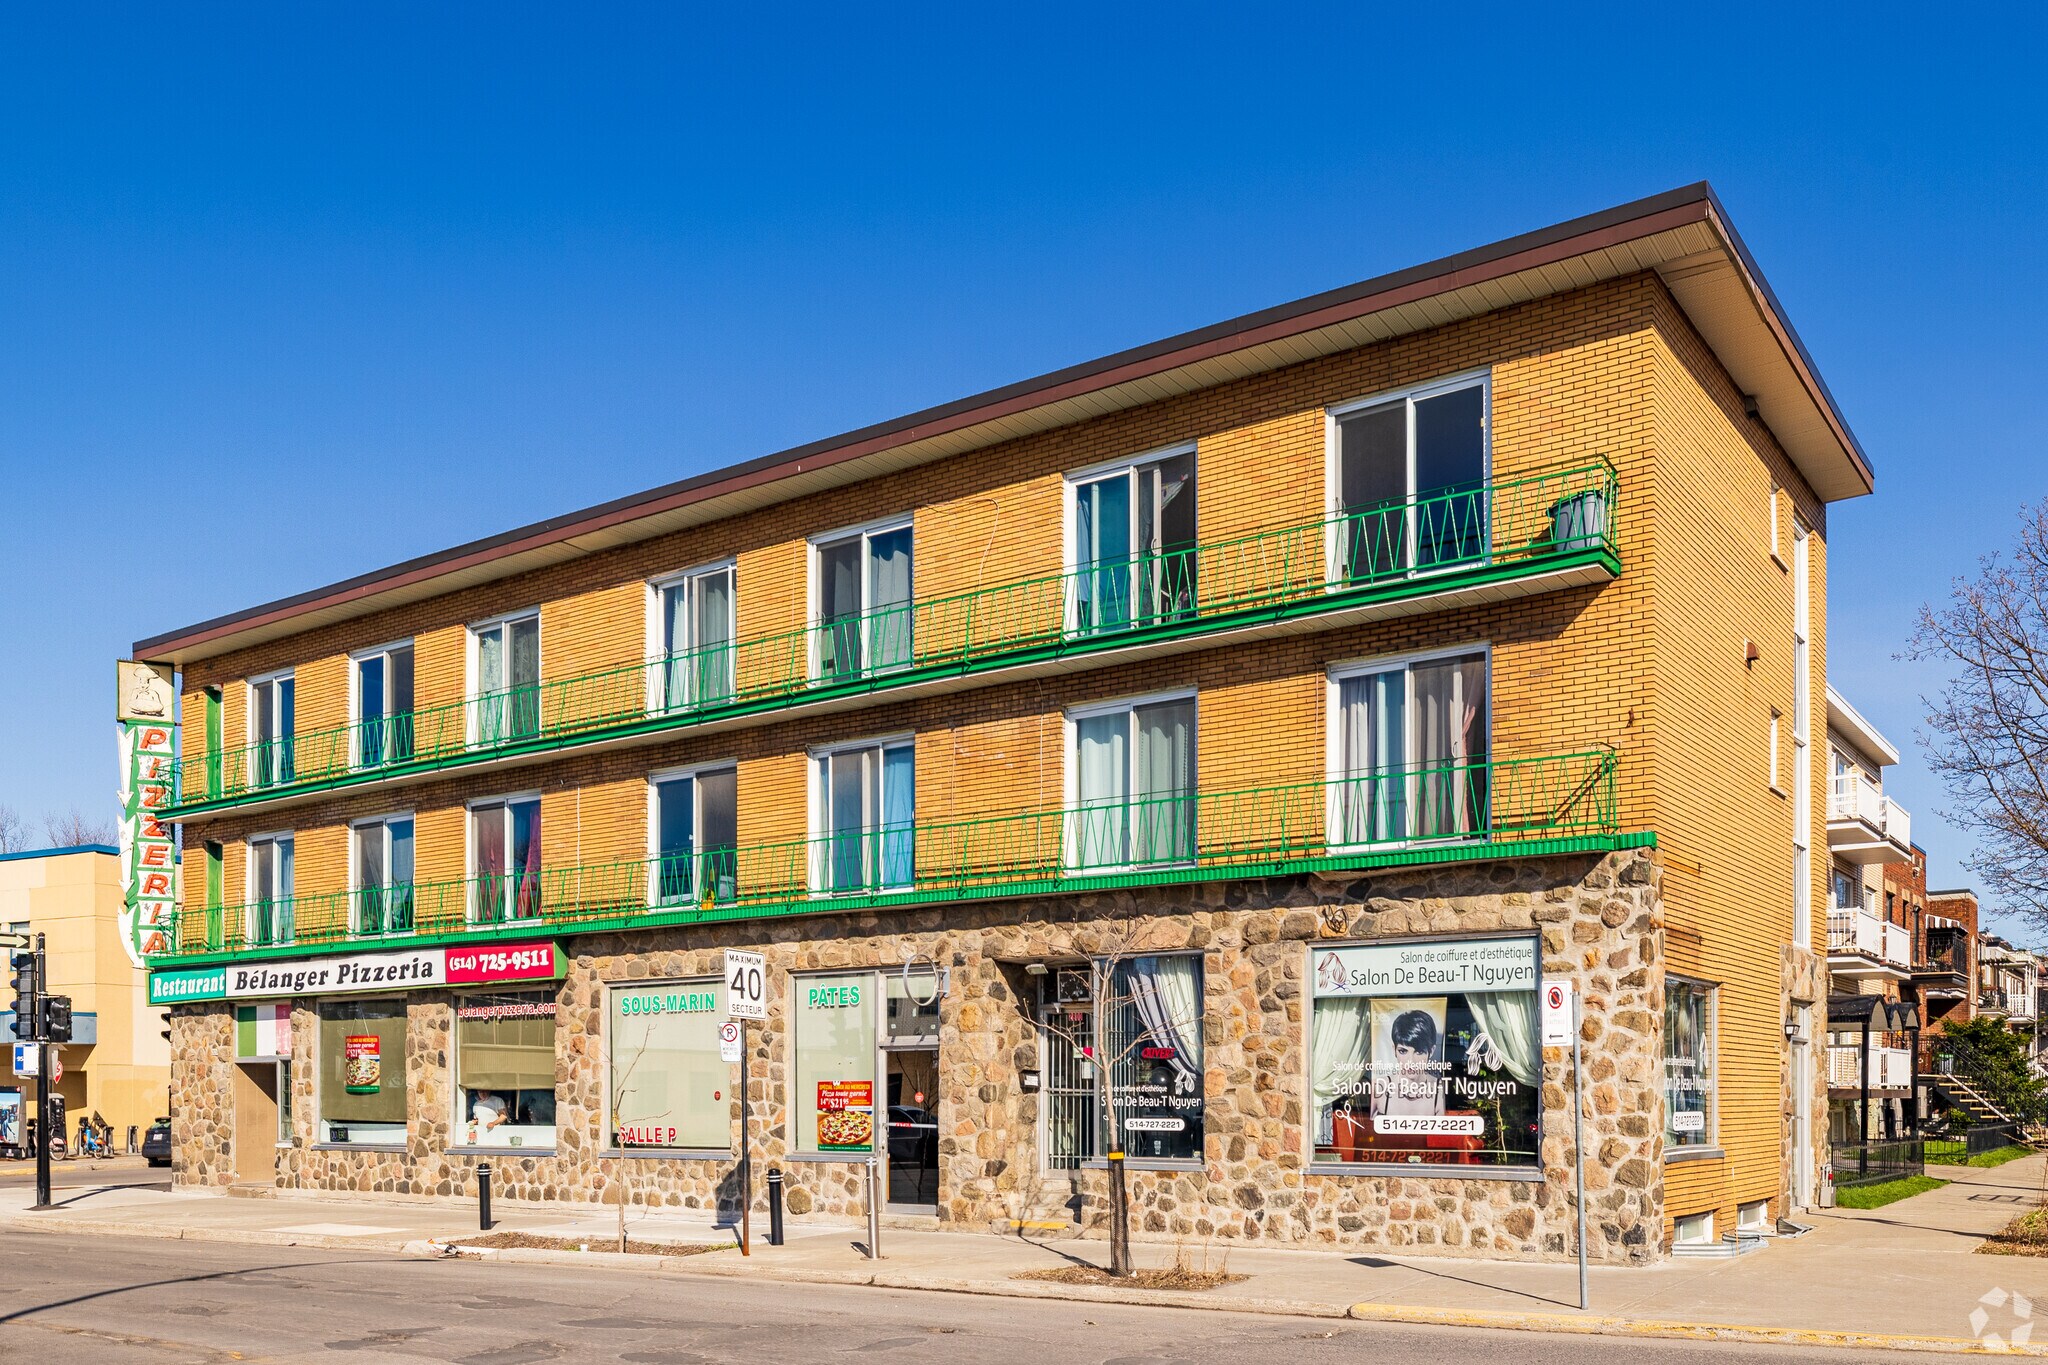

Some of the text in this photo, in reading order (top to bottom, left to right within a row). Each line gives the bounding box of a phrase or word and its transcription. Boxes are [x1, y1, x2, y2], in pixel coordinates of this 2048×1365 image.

[139, 728, 168, 954] PIZZERIA
[728, 953, 762, 966] MAXIMUM
[1400, 946, 1533, 964] Salon de coiffure et d'esthétique
[153, 949, 550, 998] Restaurant Bélanger Pizzeria (514) 725-9511
[1350, 963, 1534, 986] Salon De Beau-T Nguyen
[730, 966, 762, 1002] 40
[621, 992, 716, 1015] SOUS-MARIN
[808, 983, 861, 1008] PÂTES
[731, 1003, 763, 1015] SECTEUR
[1332, 1059, 1452, 1072] Salon de coiffure et d'esthétique
[1332, 1076, 1517, 1100] Salon De Beau-T Nguyen
[1101, 1095, 1202, 1110] Son De Beau-T Nguyen
[1129, 1120, 1181, 1129] 514-727-2221
[1382, 1119, 1476, 1131] 514-727-2221
[617, 1126, 677, 1144] SALLE P
